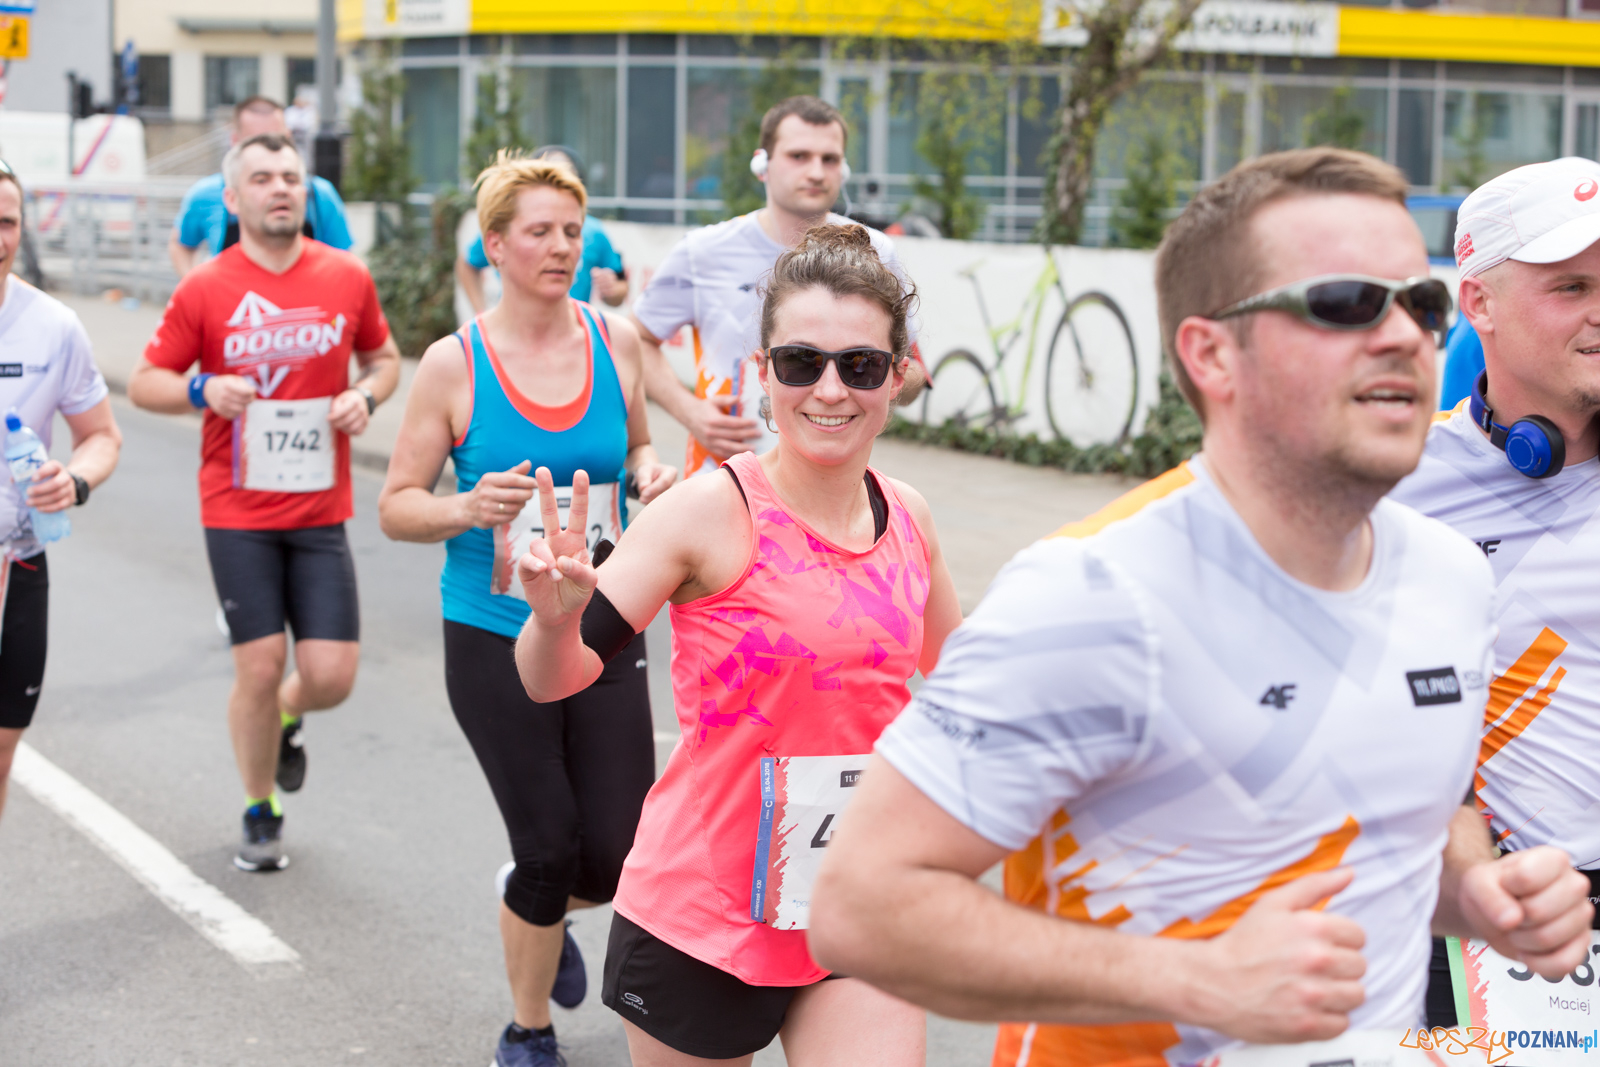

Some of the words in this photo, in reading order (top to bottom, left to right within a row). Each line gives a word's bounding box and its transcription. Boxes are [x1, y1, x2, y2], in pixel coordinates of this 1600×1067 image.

[224, 313, 347, 359] DOGON
[264, 428, 320, 451] 1742
[1475, 539, 1501, 558] F
[1259, 684, 1296, 709] 4F
[1549, 996, 1591, 1015] Maciej
